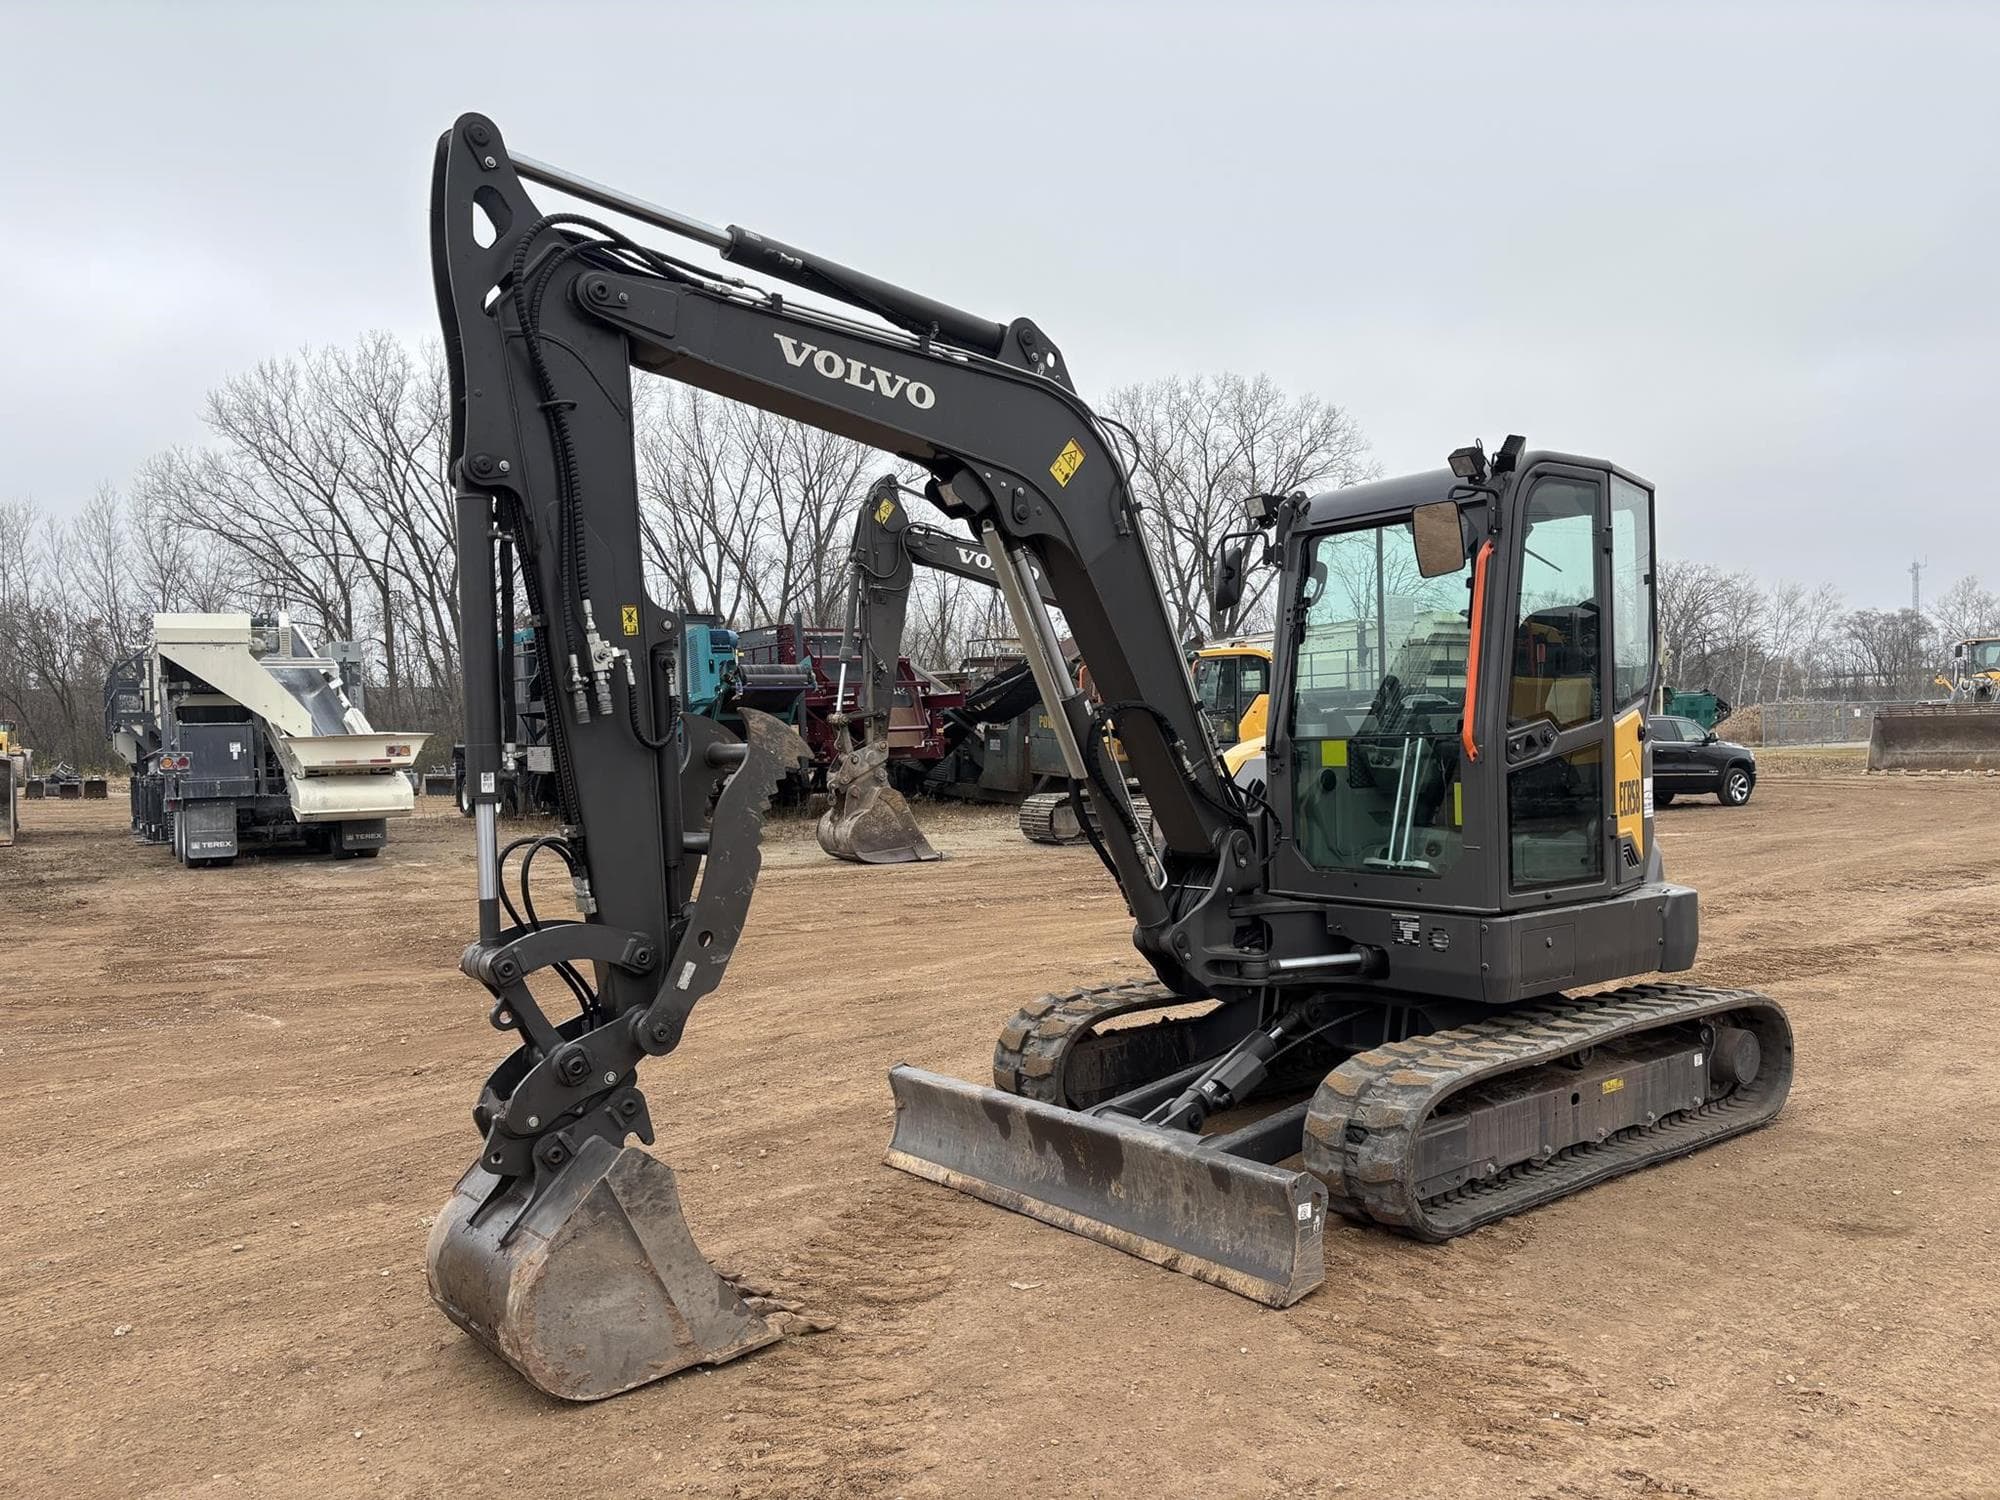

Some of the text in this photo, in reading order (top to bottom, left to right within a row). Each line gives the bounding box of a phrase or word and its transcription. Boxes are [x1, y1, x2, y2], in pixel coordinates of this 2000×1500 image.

[773, 332, 936, 409] VOLVO
[1619, 779, 1640, 817] ECR58
[201, 840, 233, 849] TEREX
